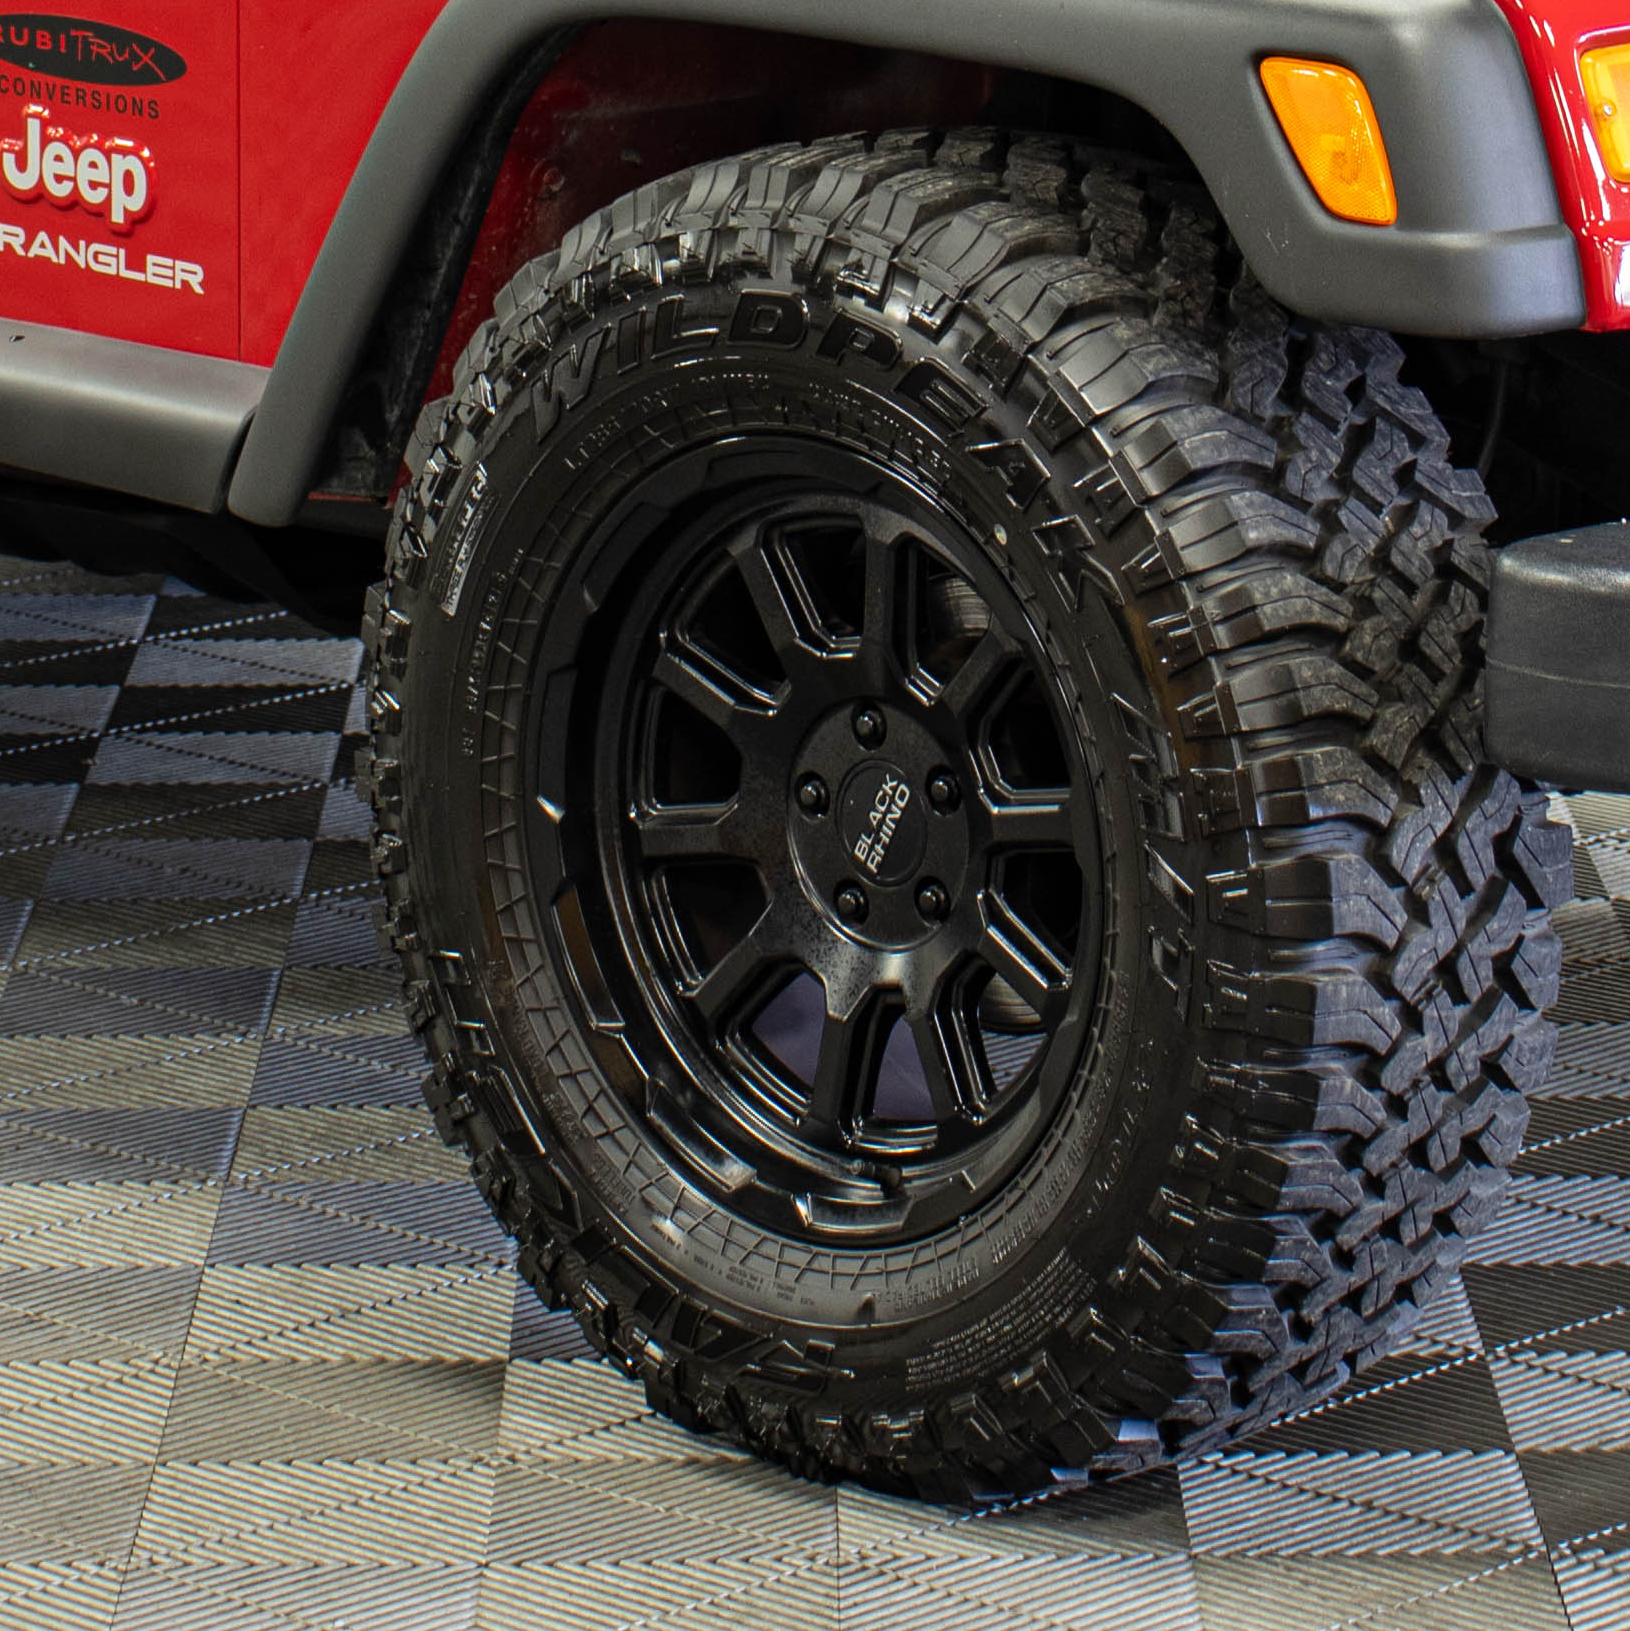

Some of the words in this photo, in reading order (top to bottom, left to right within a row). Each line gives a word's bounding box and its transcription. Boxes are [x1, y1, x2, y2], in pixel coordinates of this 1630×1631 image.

[2, 114, 150, 225] Jeep
[530, 286, 1126, 612] WILDPEAK
[854, 773, 898, 862] BLACK
[866, 783, 911, 874] RHINO
